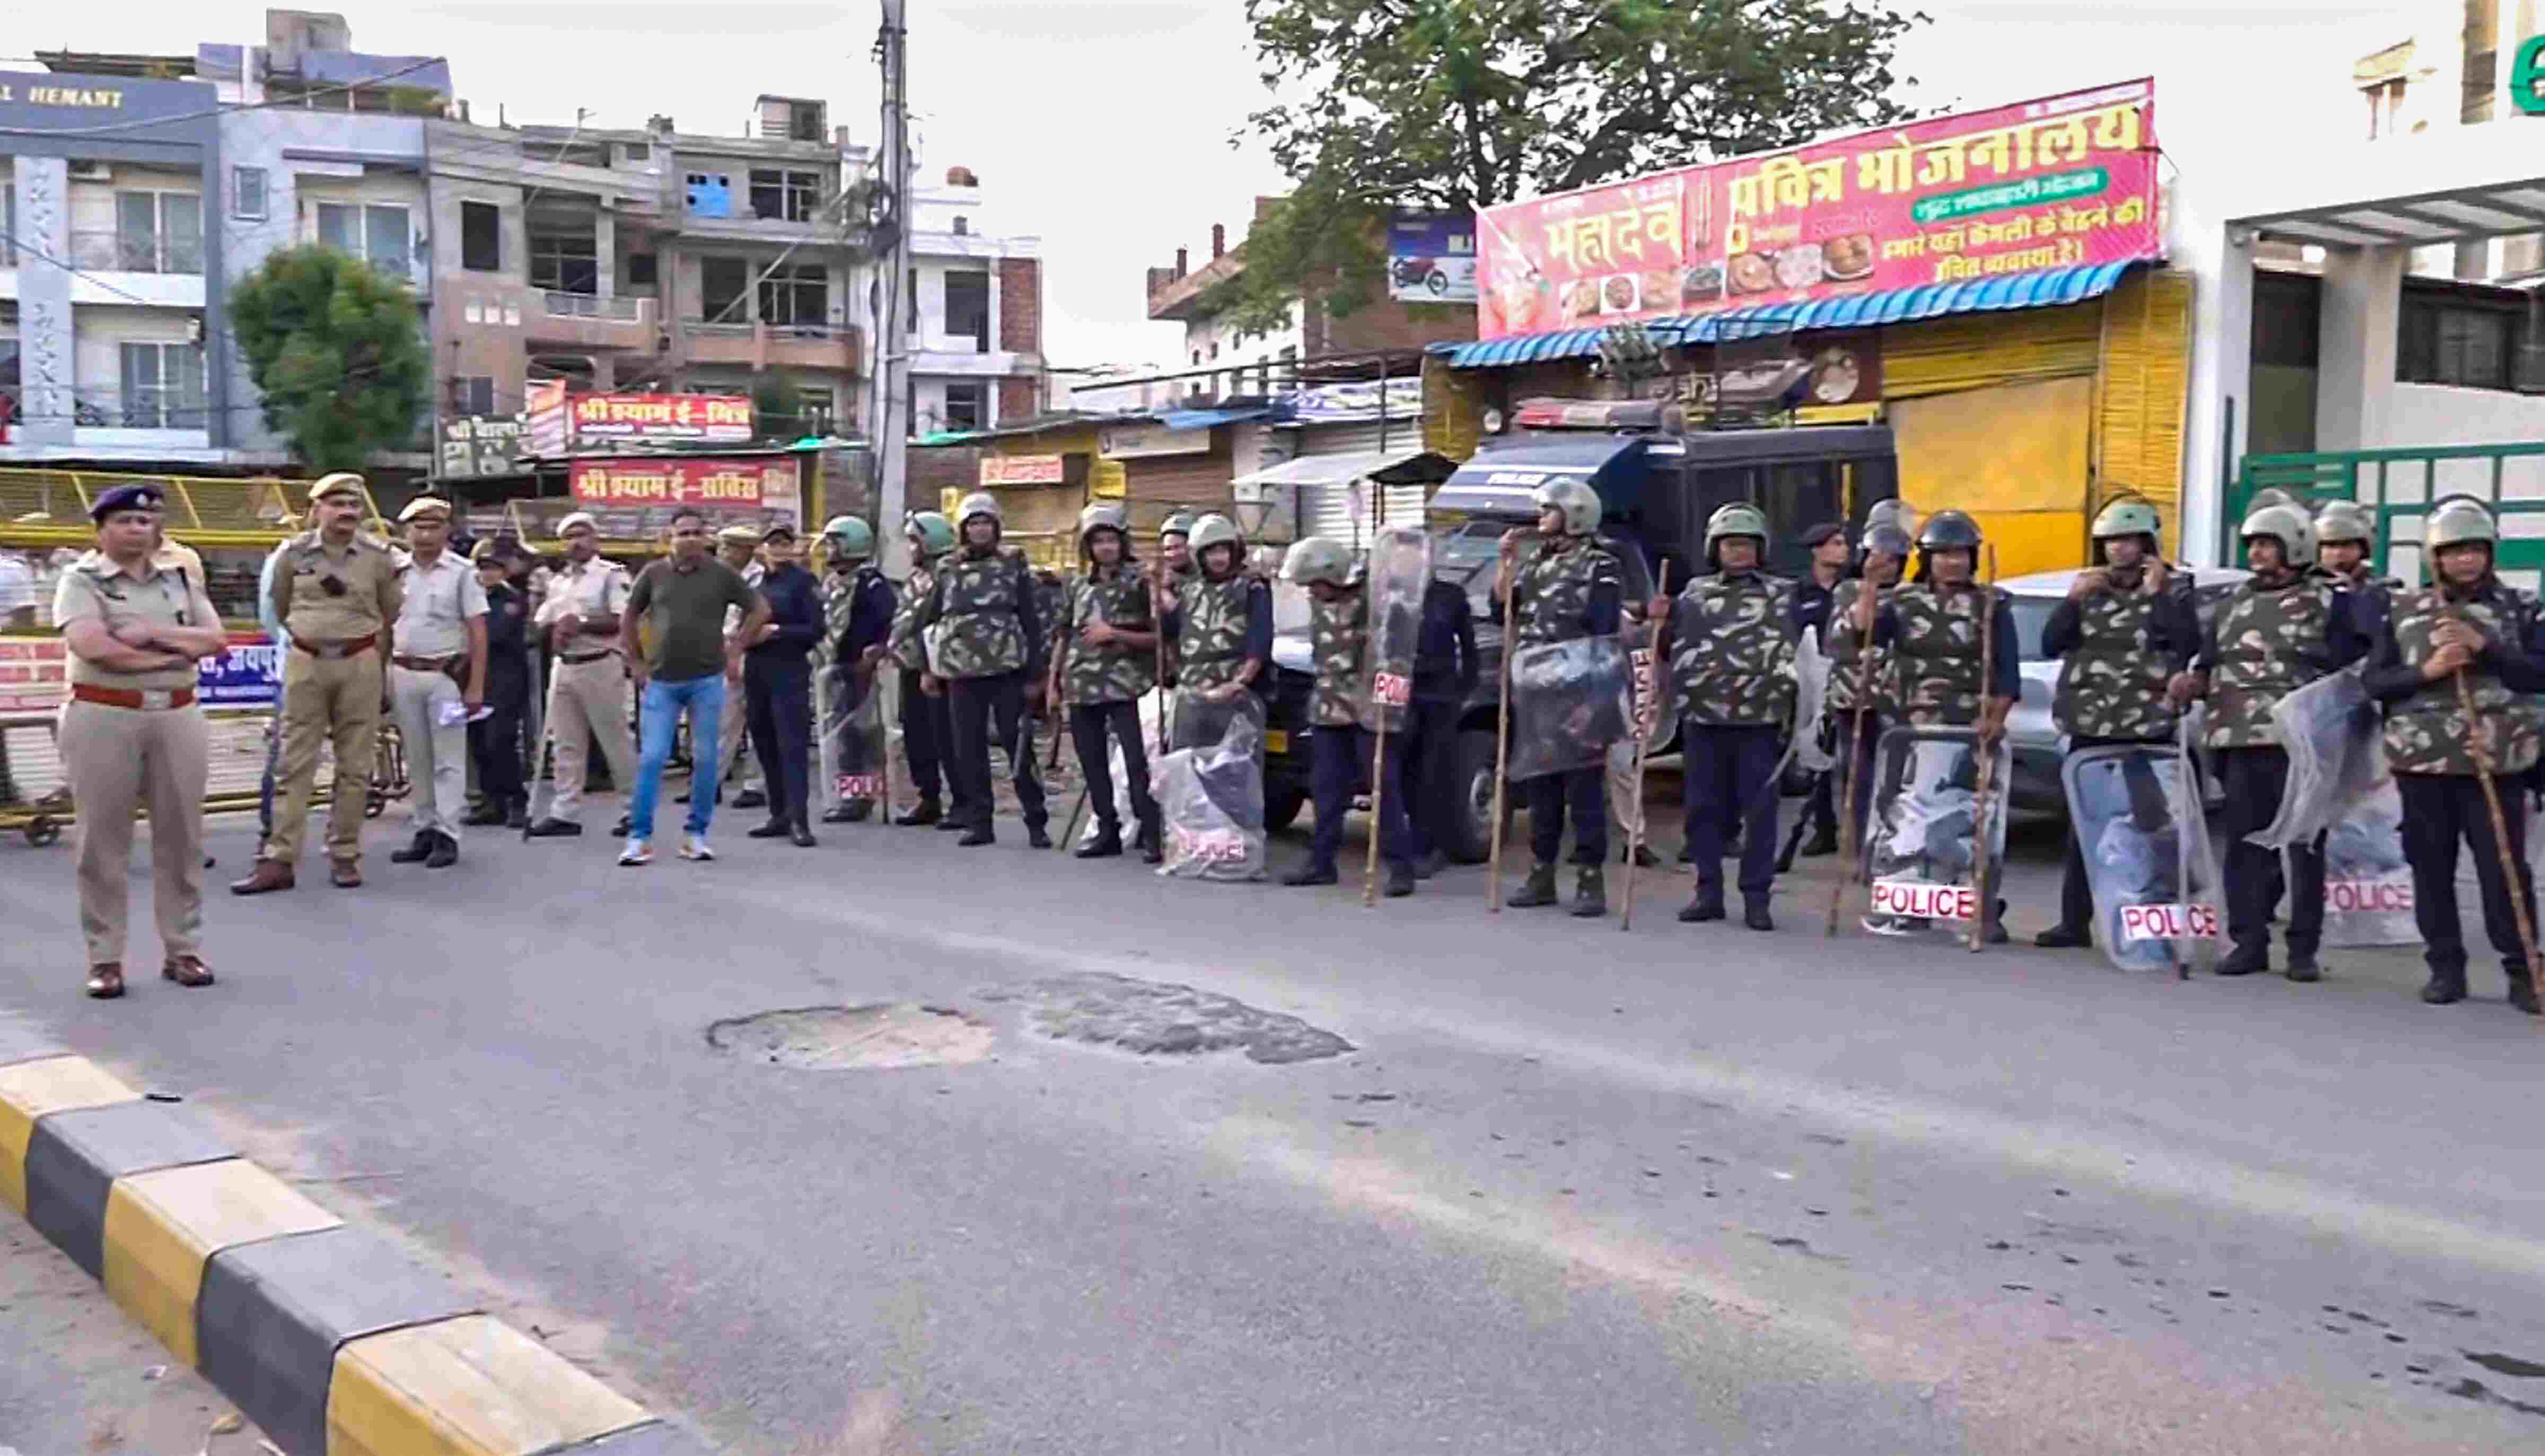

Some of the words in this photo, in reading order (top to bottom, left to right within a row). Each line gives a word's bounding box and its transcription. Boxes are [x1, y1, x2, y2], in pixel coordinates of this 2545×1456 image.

[30, 87, 122, 108] HEMANT
[1544, 189, 1683, 276] महादेव
[1728, 155, 1847, 216] पवित्र
[1857, 103, 2141, 194] भोजनालय
[1874, 884, 1974, 918] POLICE
[2126, 906, 2217, 936] POLCE
